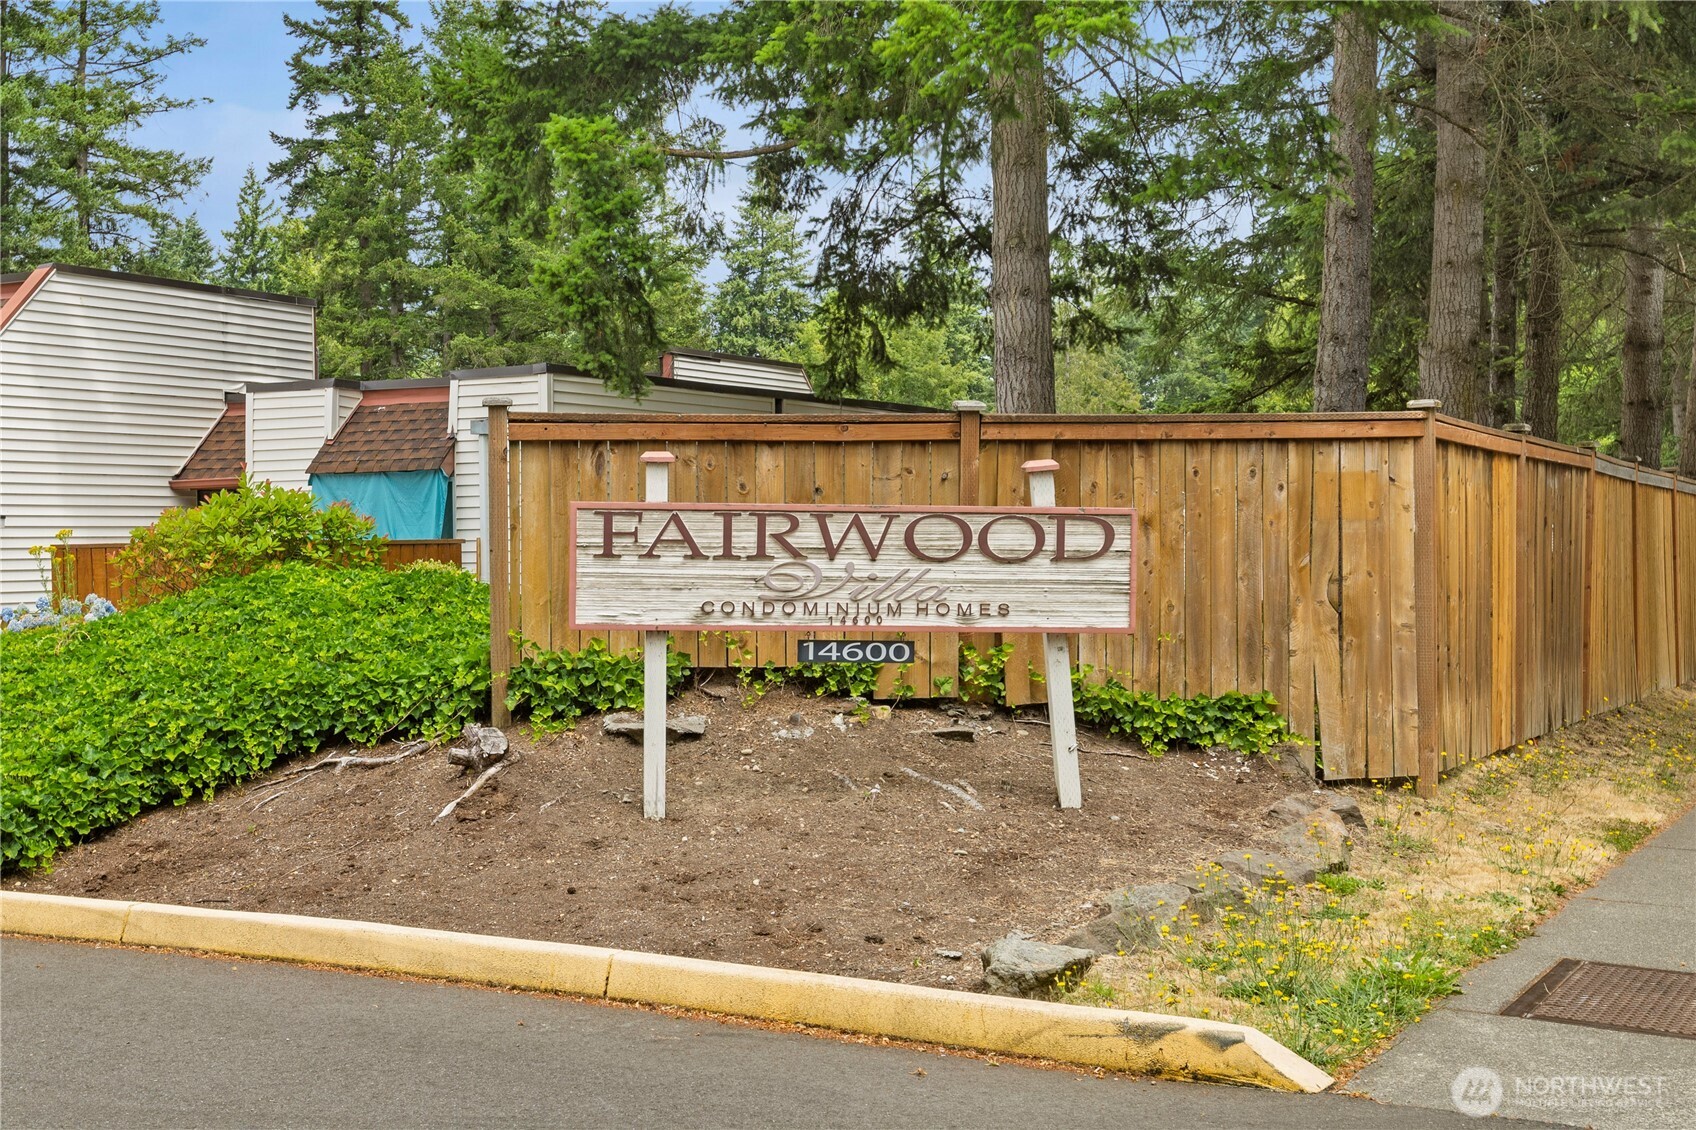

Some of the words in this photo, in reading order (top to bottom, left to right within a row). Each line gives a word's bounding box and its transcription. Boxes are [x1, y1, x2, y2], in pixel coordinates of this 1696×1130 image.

[593, 511, 1115, 563] FAIRWOOD
[754, 561, 948, 601] Villa
[700, 601, 903, 617] CONDOMINIUM
[916, 603, 1010, 617] HOMES
[828, 615, 883, 626] 14600
[802, 642, 911, 662] 14600
